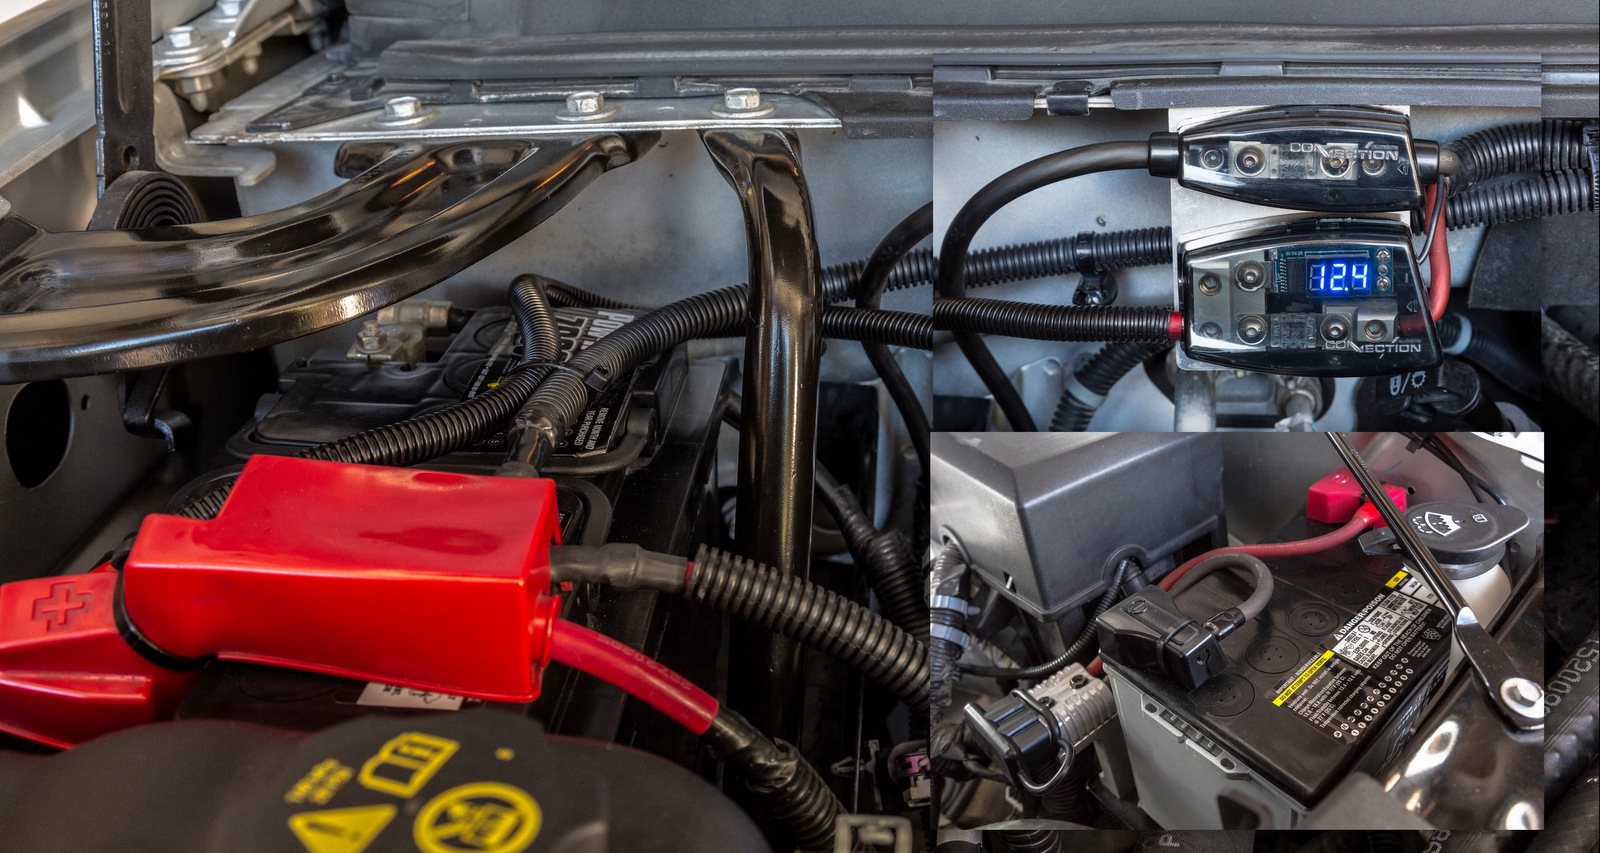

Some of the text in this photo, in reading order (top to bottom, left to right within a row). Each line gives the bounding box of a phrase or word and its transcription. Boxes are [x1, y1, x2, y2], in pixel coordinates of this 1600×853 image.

[1319, 263, 1368, 292] 12.4
[1326, 340, 1422, 353] CONNECTION
[1341, 593, 1386, 636] DANGER/POISON
[1400, 636, 1412, 647] OPEN
[1371, 658, 1384, 669] KEEP
[1290, 676, 1305, 690] ATTEMPT
[1307, 665, 1317, 674] OPEN
